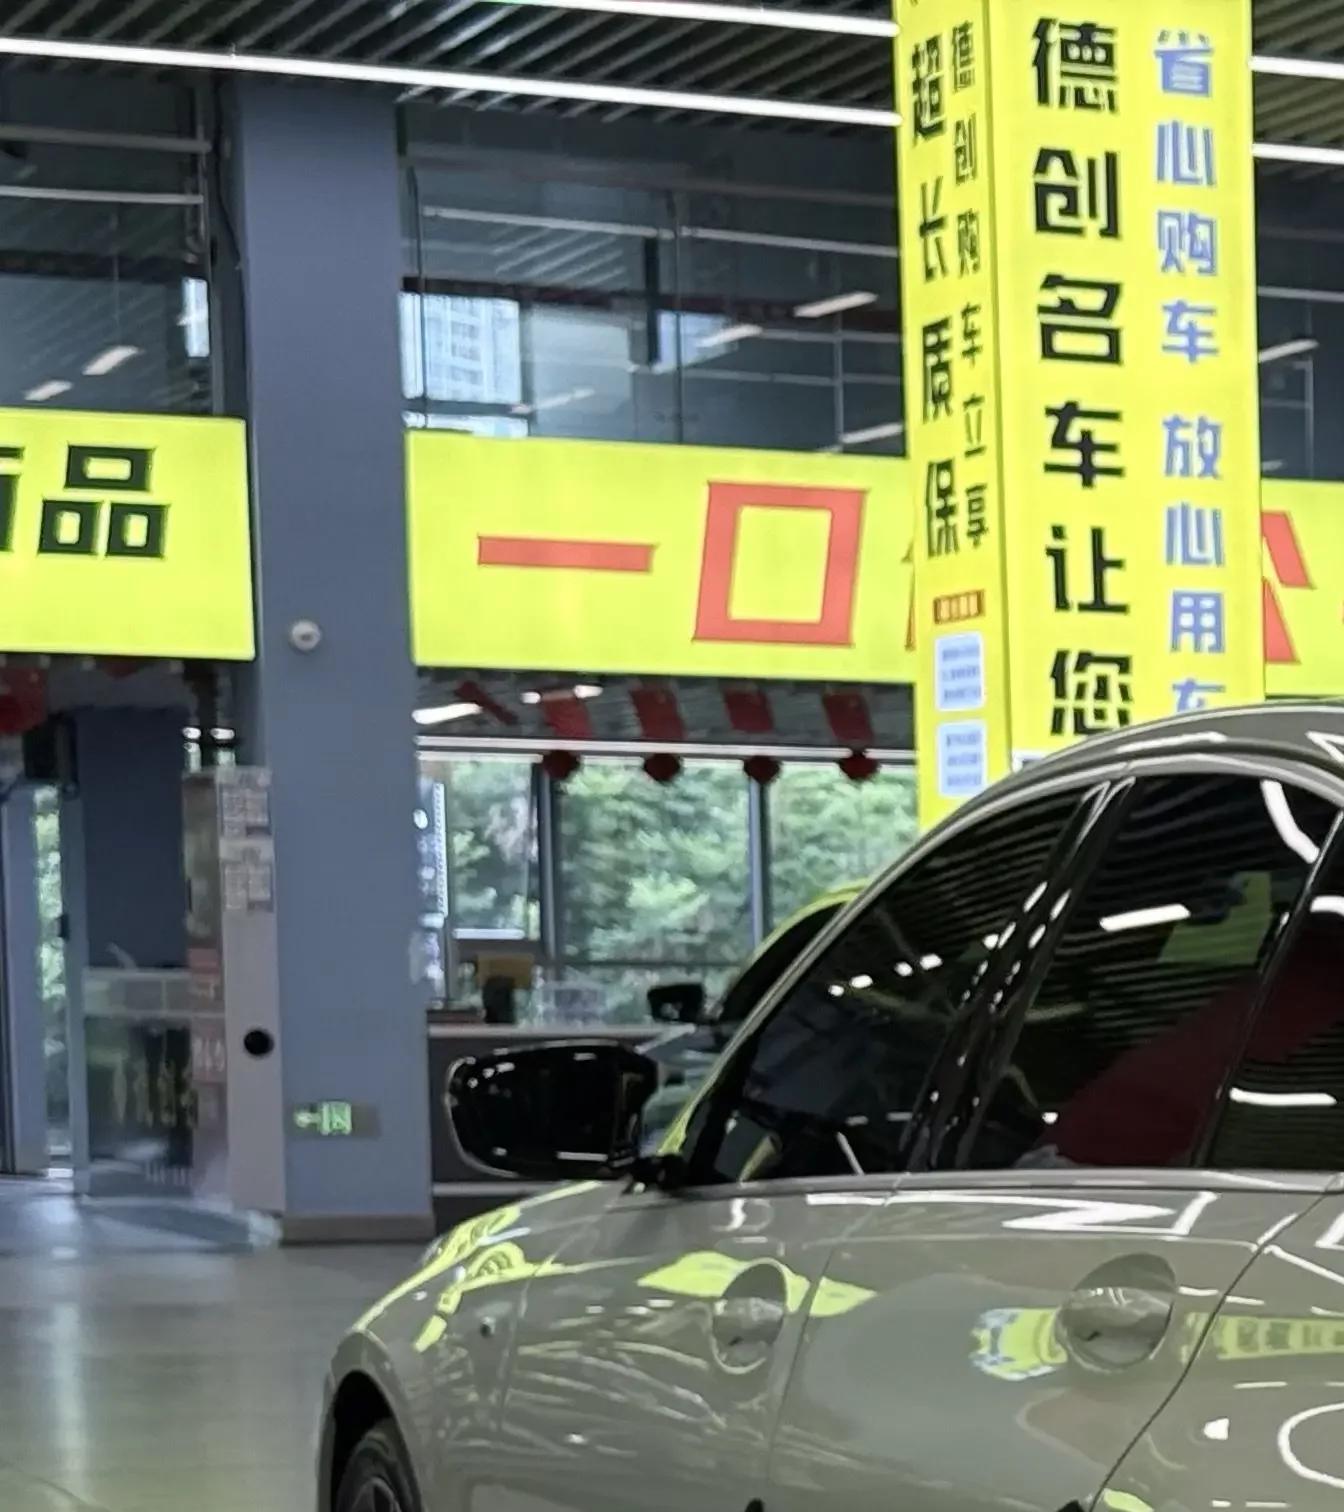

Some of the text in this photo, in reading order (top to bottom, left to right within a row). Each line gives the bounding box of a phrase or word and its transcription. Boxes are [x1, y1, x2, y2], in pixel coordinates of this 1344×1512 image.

[1154, 29, 1220, 364] 省心购车
[0, 443, 170, 560] 品
[1031, 17, 1133, 736] 德创名车让您
[477, 481, 915, 652] 一口
